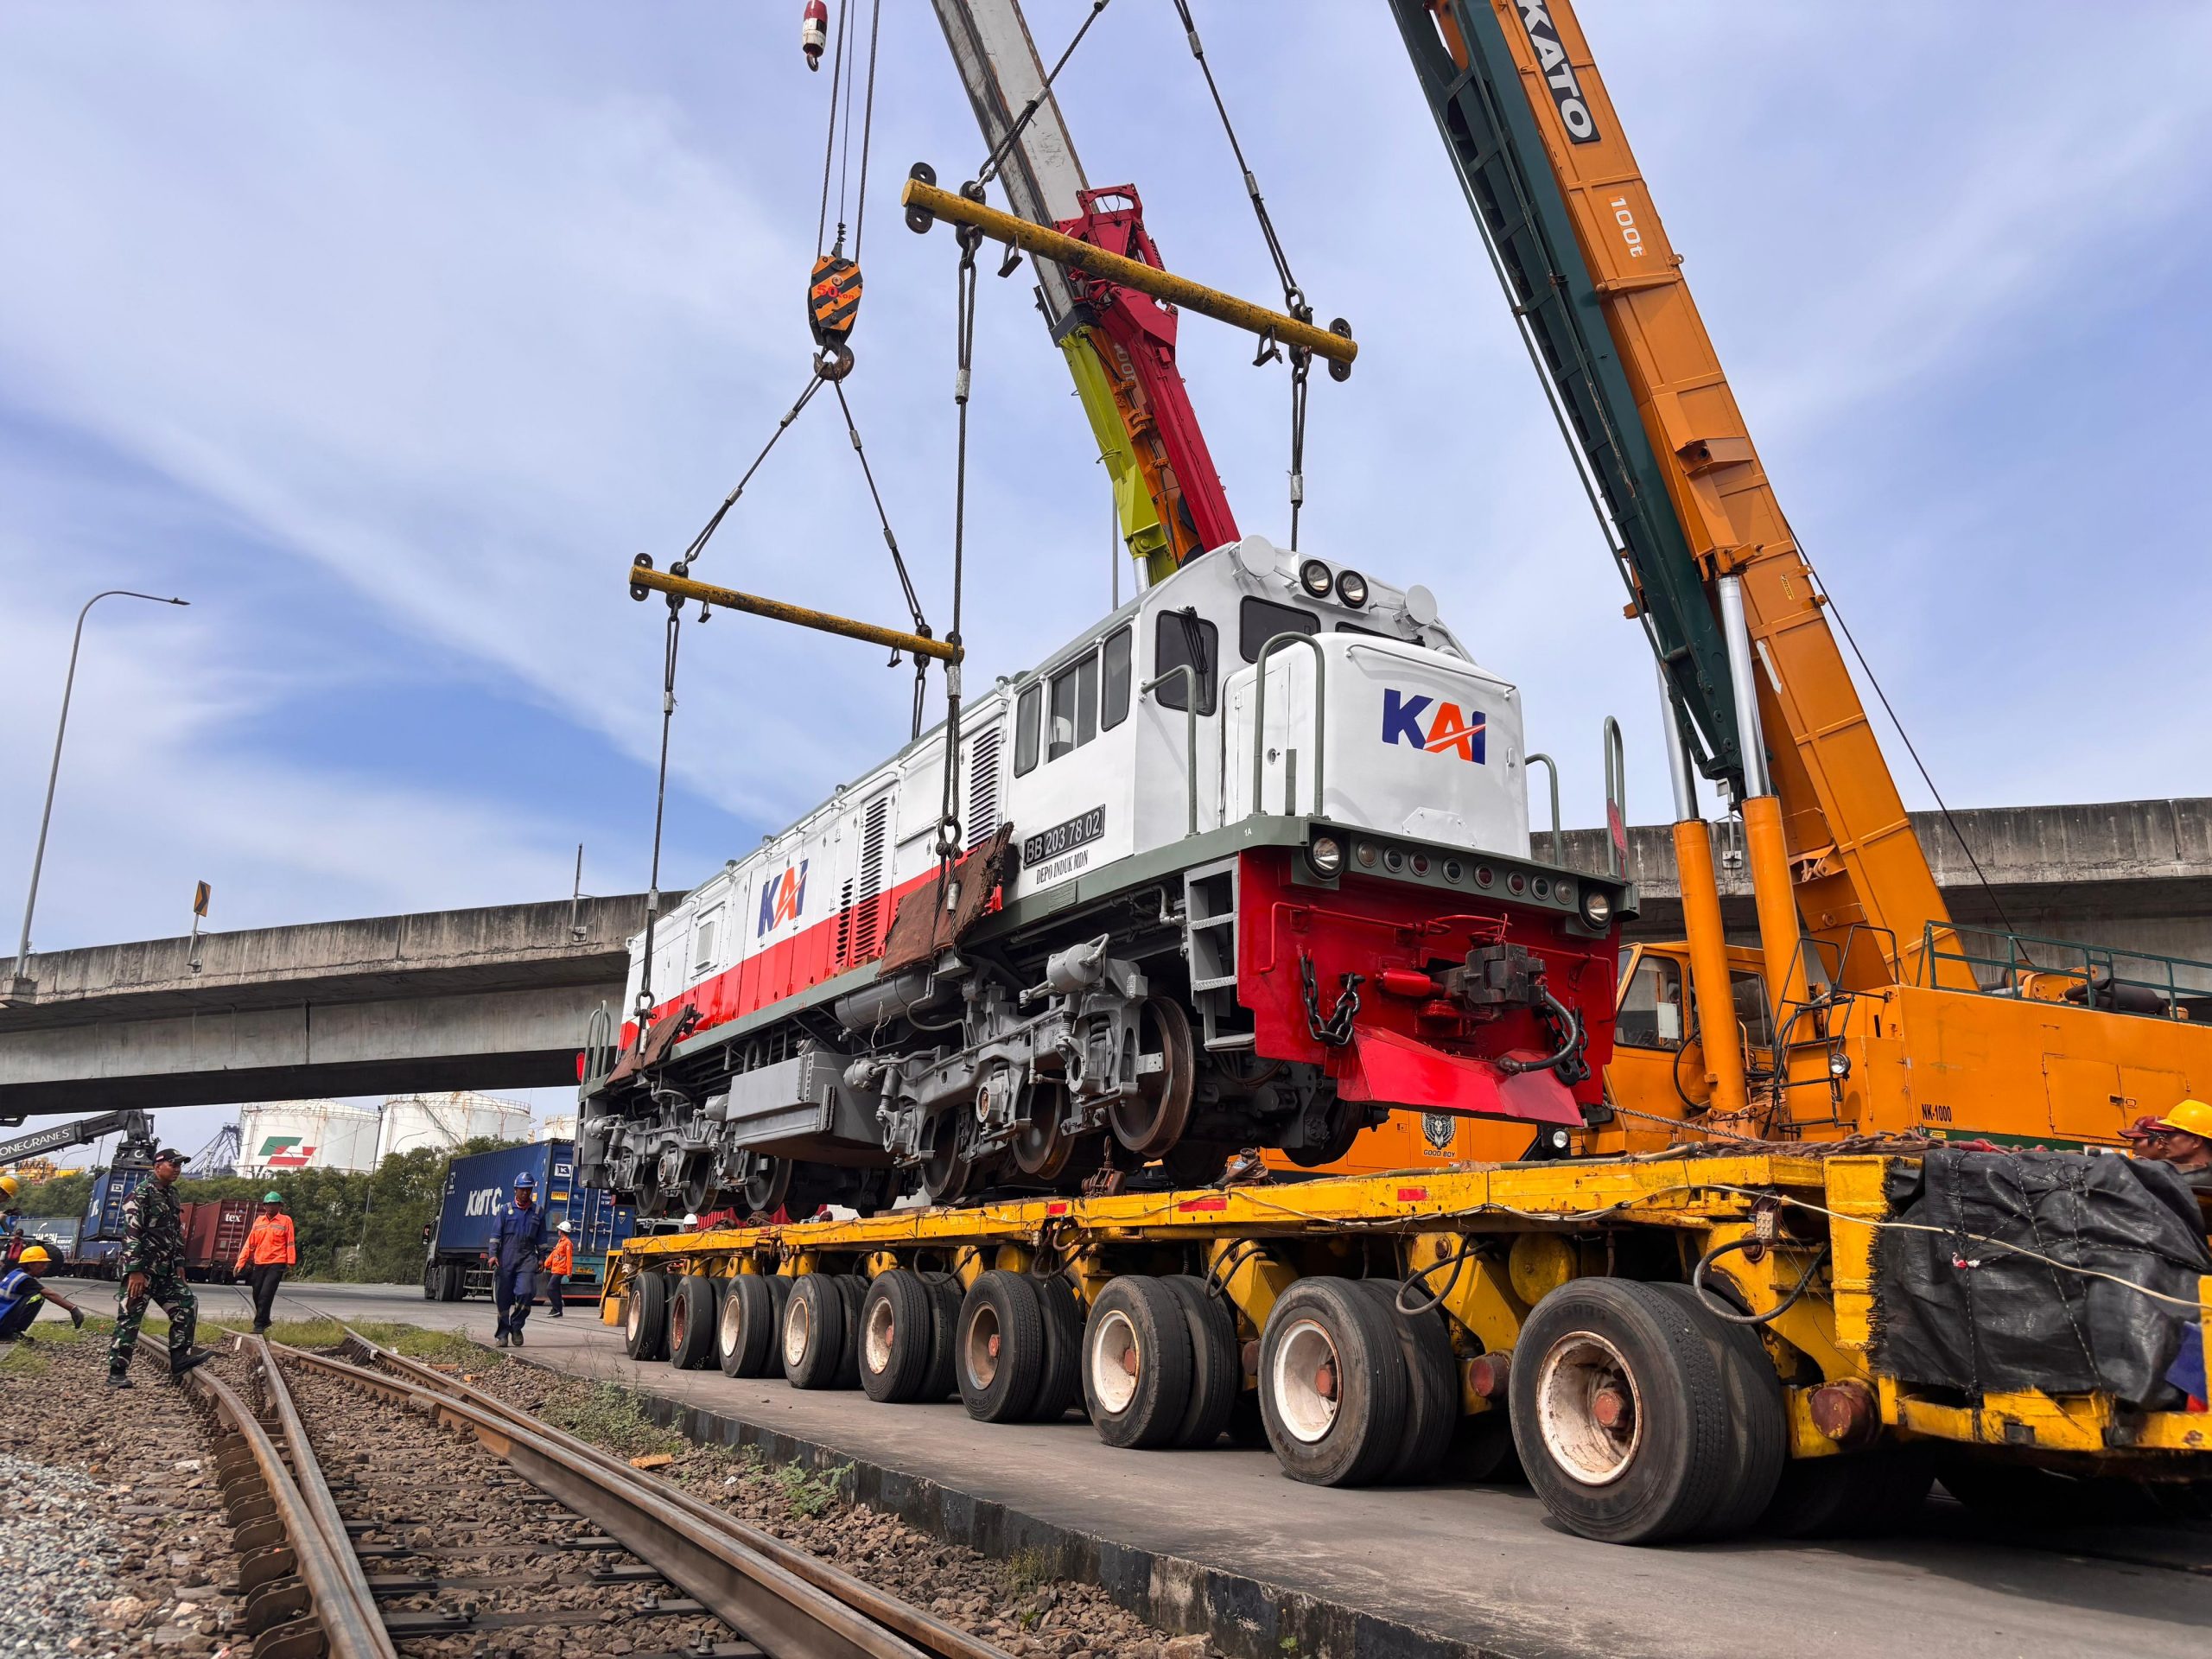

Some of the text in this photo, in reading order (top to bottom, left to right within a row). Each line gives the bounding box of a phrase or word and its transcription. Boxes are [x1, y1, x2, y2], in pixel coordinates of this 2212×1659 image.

[1518, 0, 1592, 138] KATO
[1611, 197, 1643, 257] 100t
[1382, 688, 1486, 766] KAI
[1026, 810, 1100, 863] BB 203 78 02
[1036, 849, 1089, 885] DEPO INDUK MDN
[757, 857, 809, 939] KAI
[1921, 1103, 1952, 1122] NK-1000
[225, 1212, 242, 1223] tex
[465, 1186, 503, 1217] KMTC
